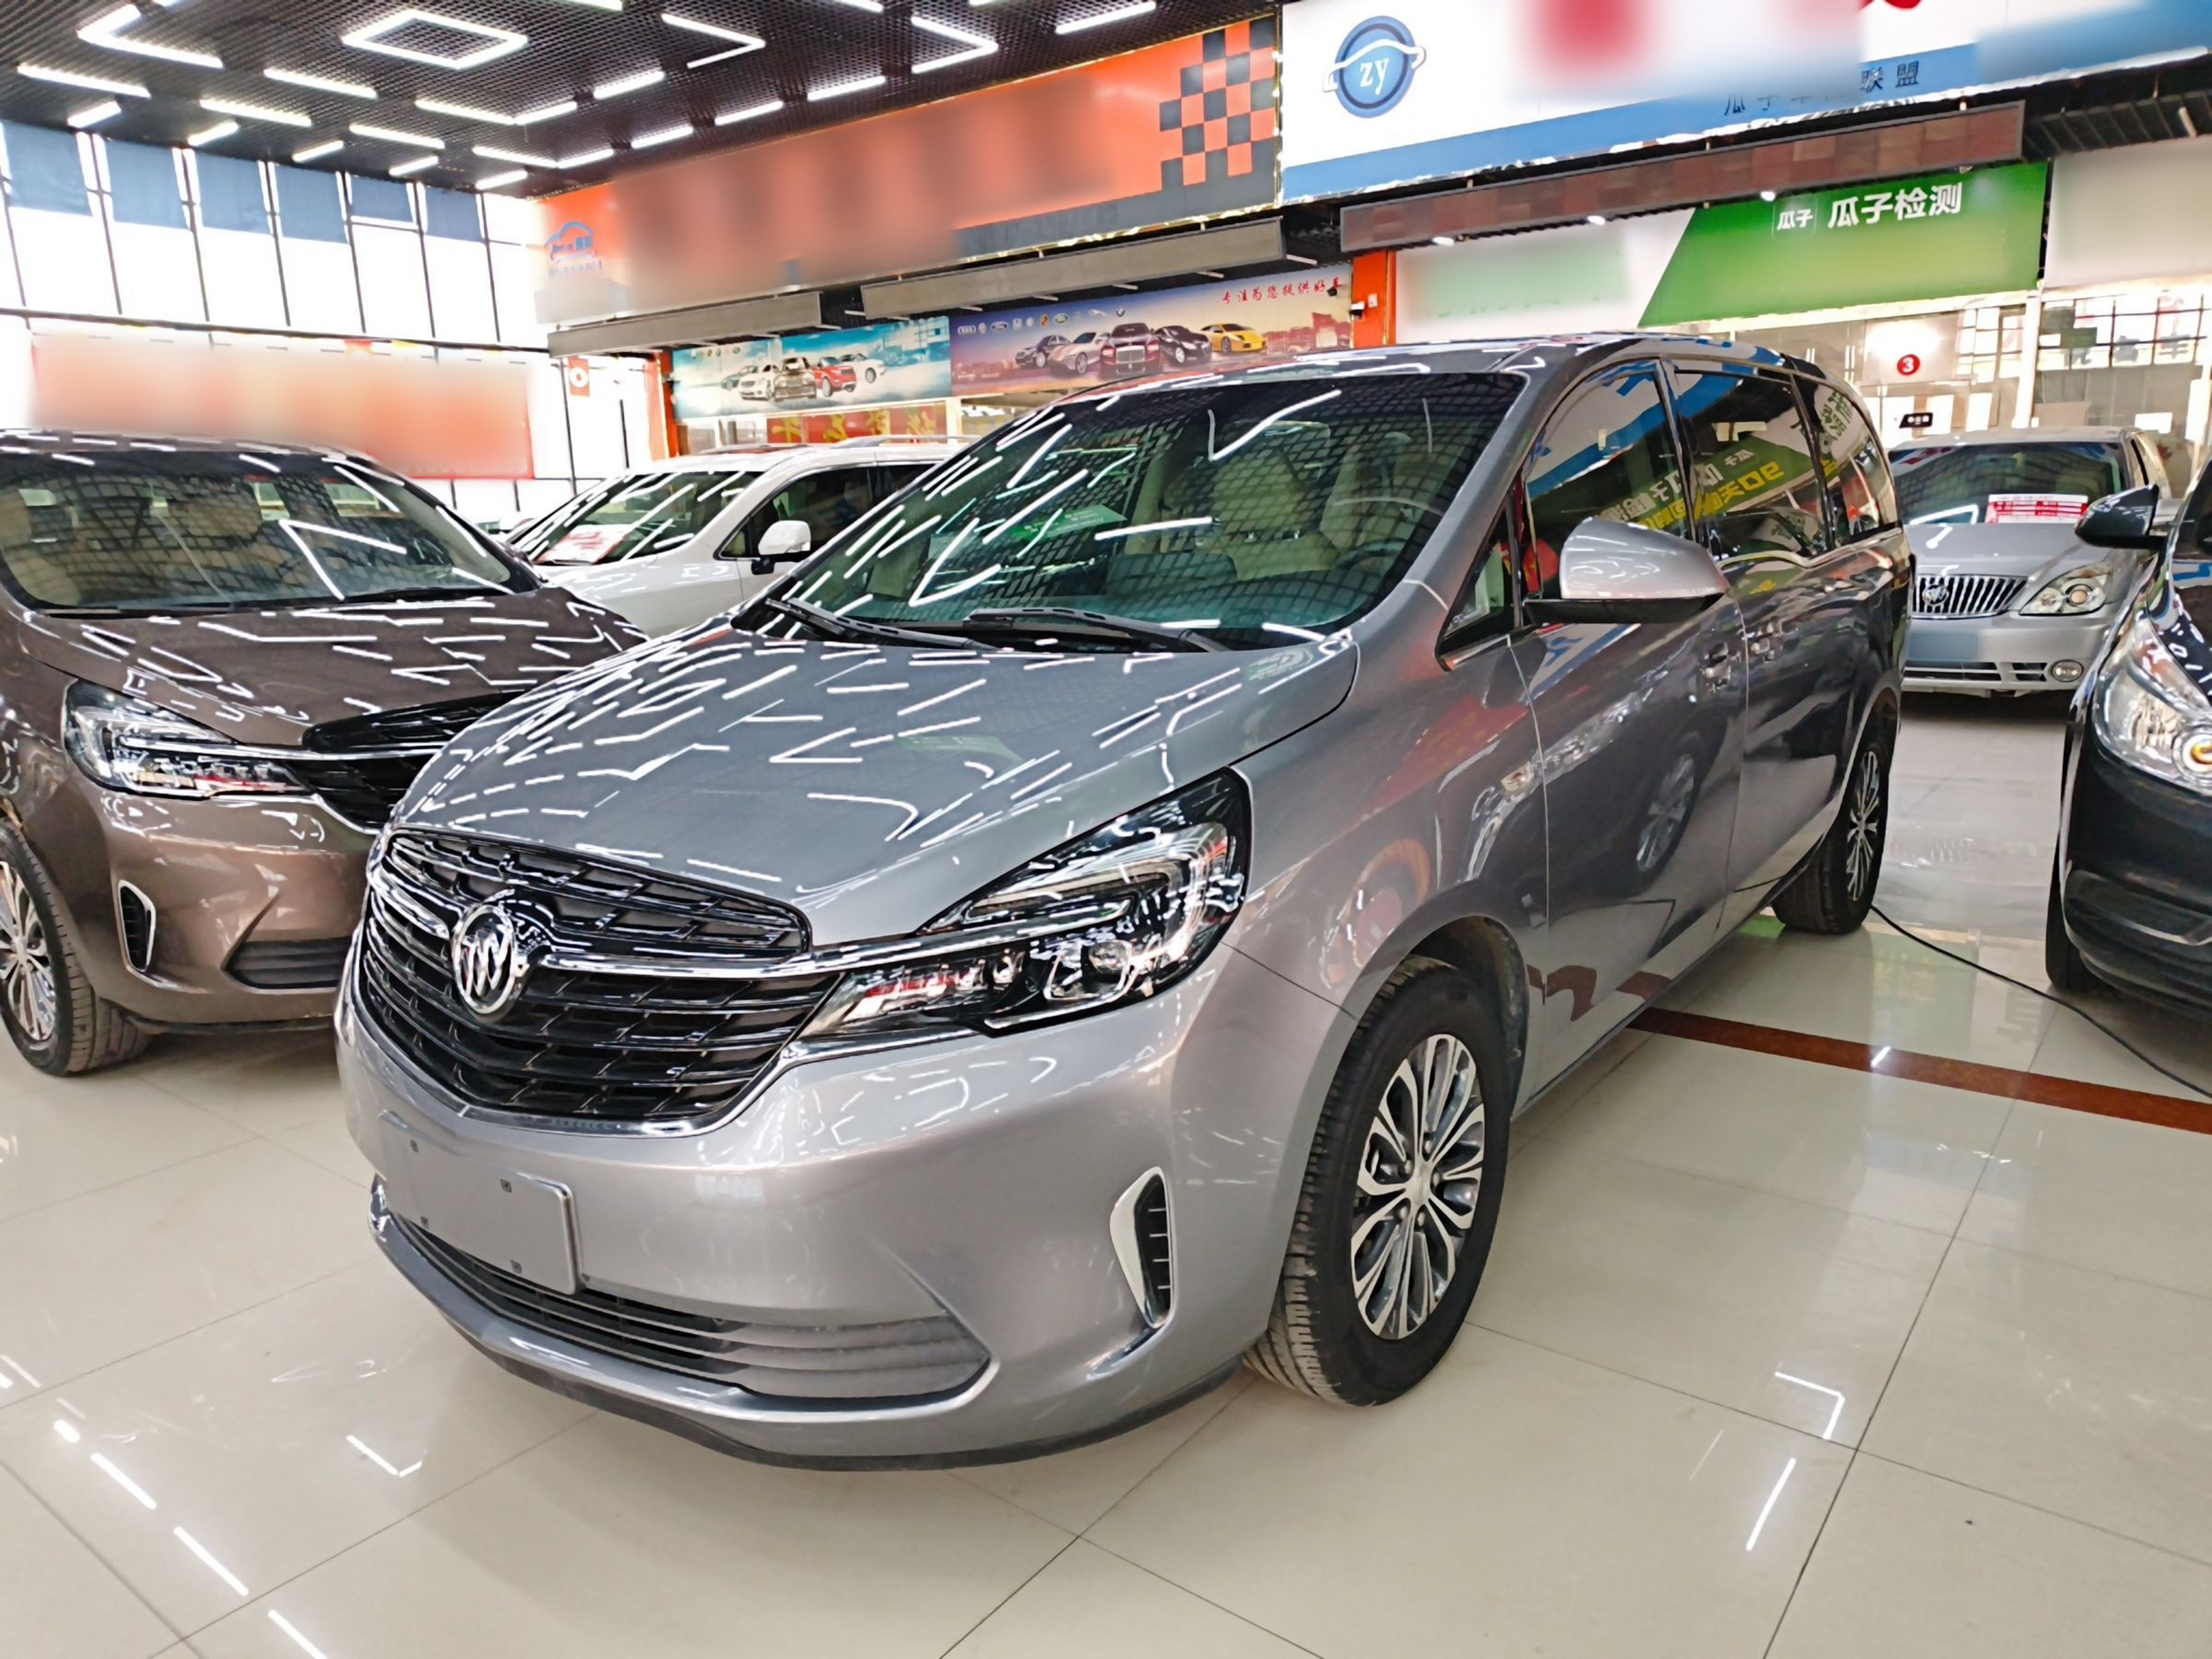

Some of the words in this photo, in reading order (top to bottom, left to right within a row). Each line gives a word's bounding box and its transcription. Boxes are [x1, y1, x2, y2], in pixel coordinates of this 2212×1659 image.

[1777, 209, 1813, 230] 瓜子
[1828, 181, 1963, 229] 瓜子检测
[1902, 357, 1914, 373] 3
